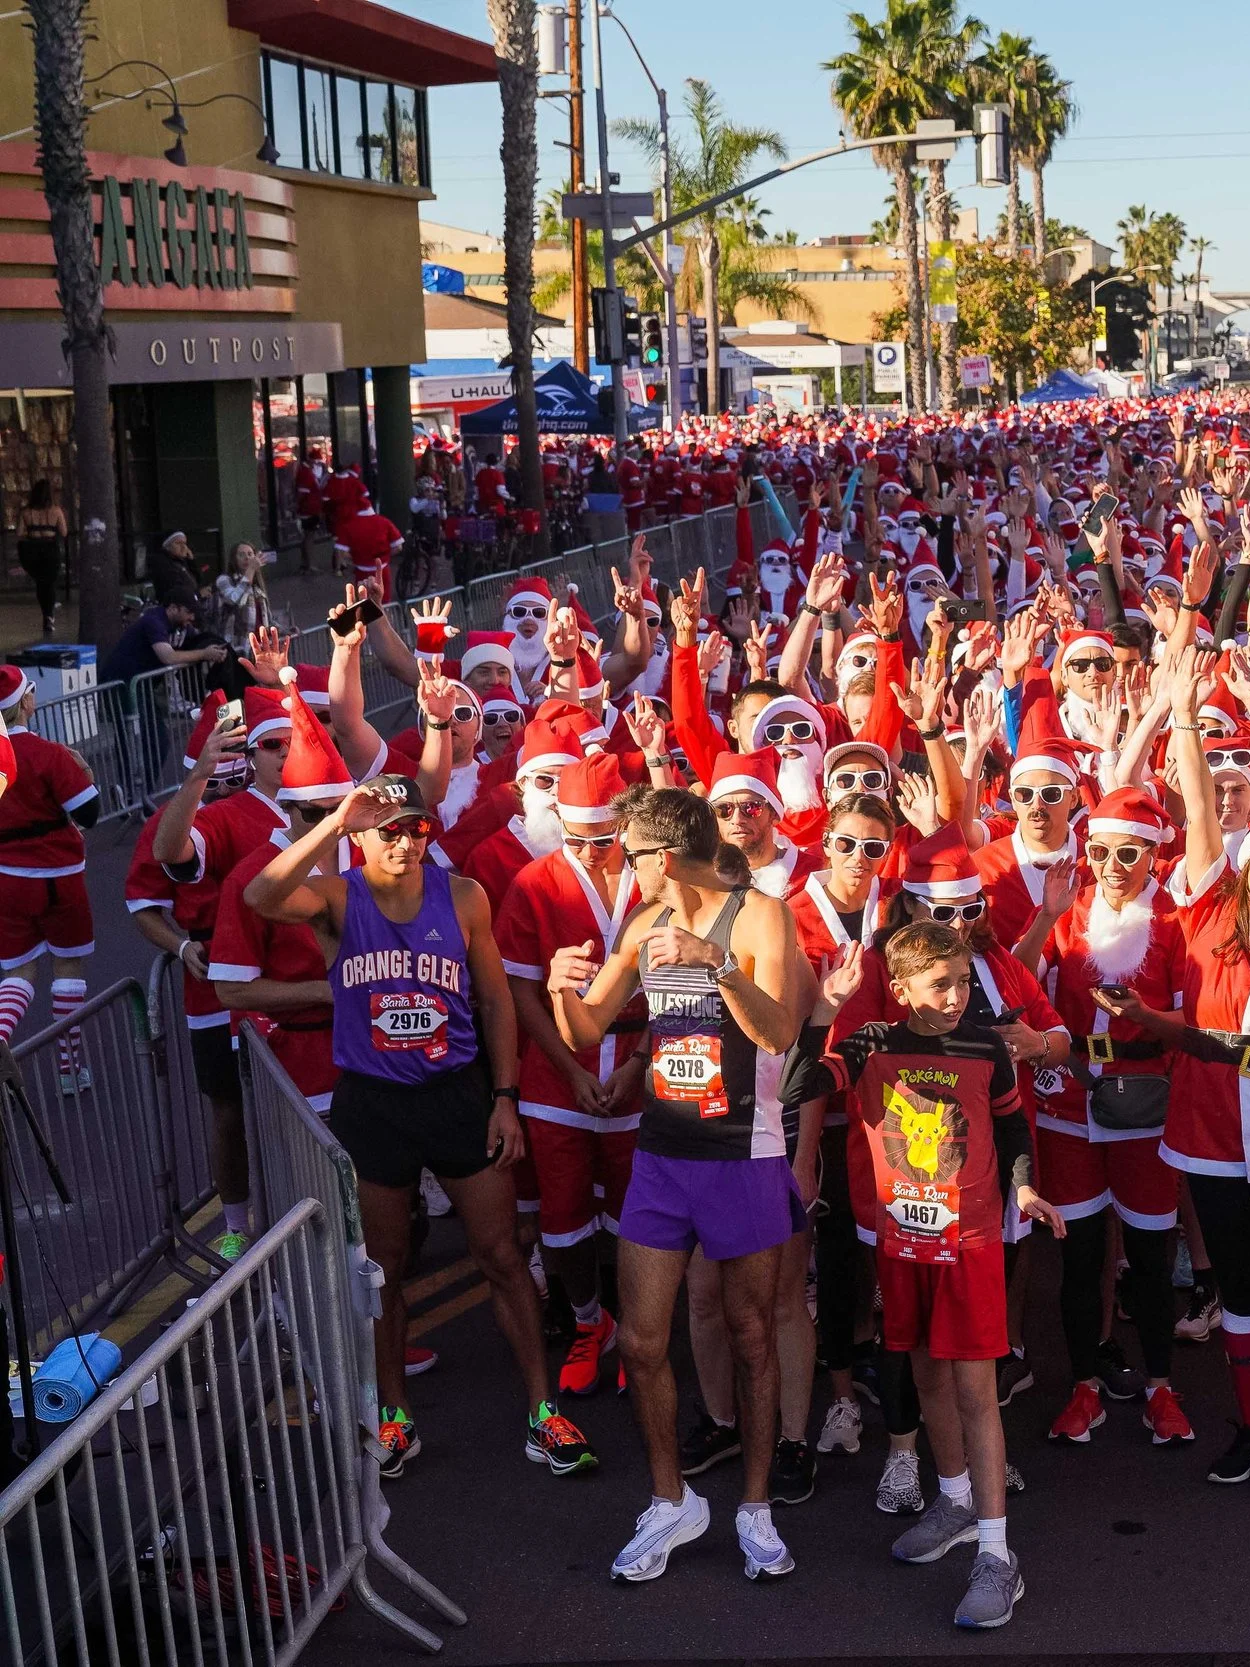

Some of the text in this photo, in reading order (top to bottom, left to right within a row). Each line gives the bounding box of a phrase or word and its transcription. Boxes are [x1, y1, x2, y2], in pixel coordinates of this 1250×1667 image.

[101, 176, 253, 290] ANGAEA
[150, 337, 296, 366] OUTPOST
[342, 949, 460, 993] ORANGE GLEN
[379, 993, 437, 1009] Santa Run
[389, 1012, 431, 1030] 2976
[659, 1037, 711, 1054] Santa Run
[668, 1058, 705, 1079] 2978
[892, 1182, 949, 1201] Santa Run
[902, 1203, 938, 1225] 1467
